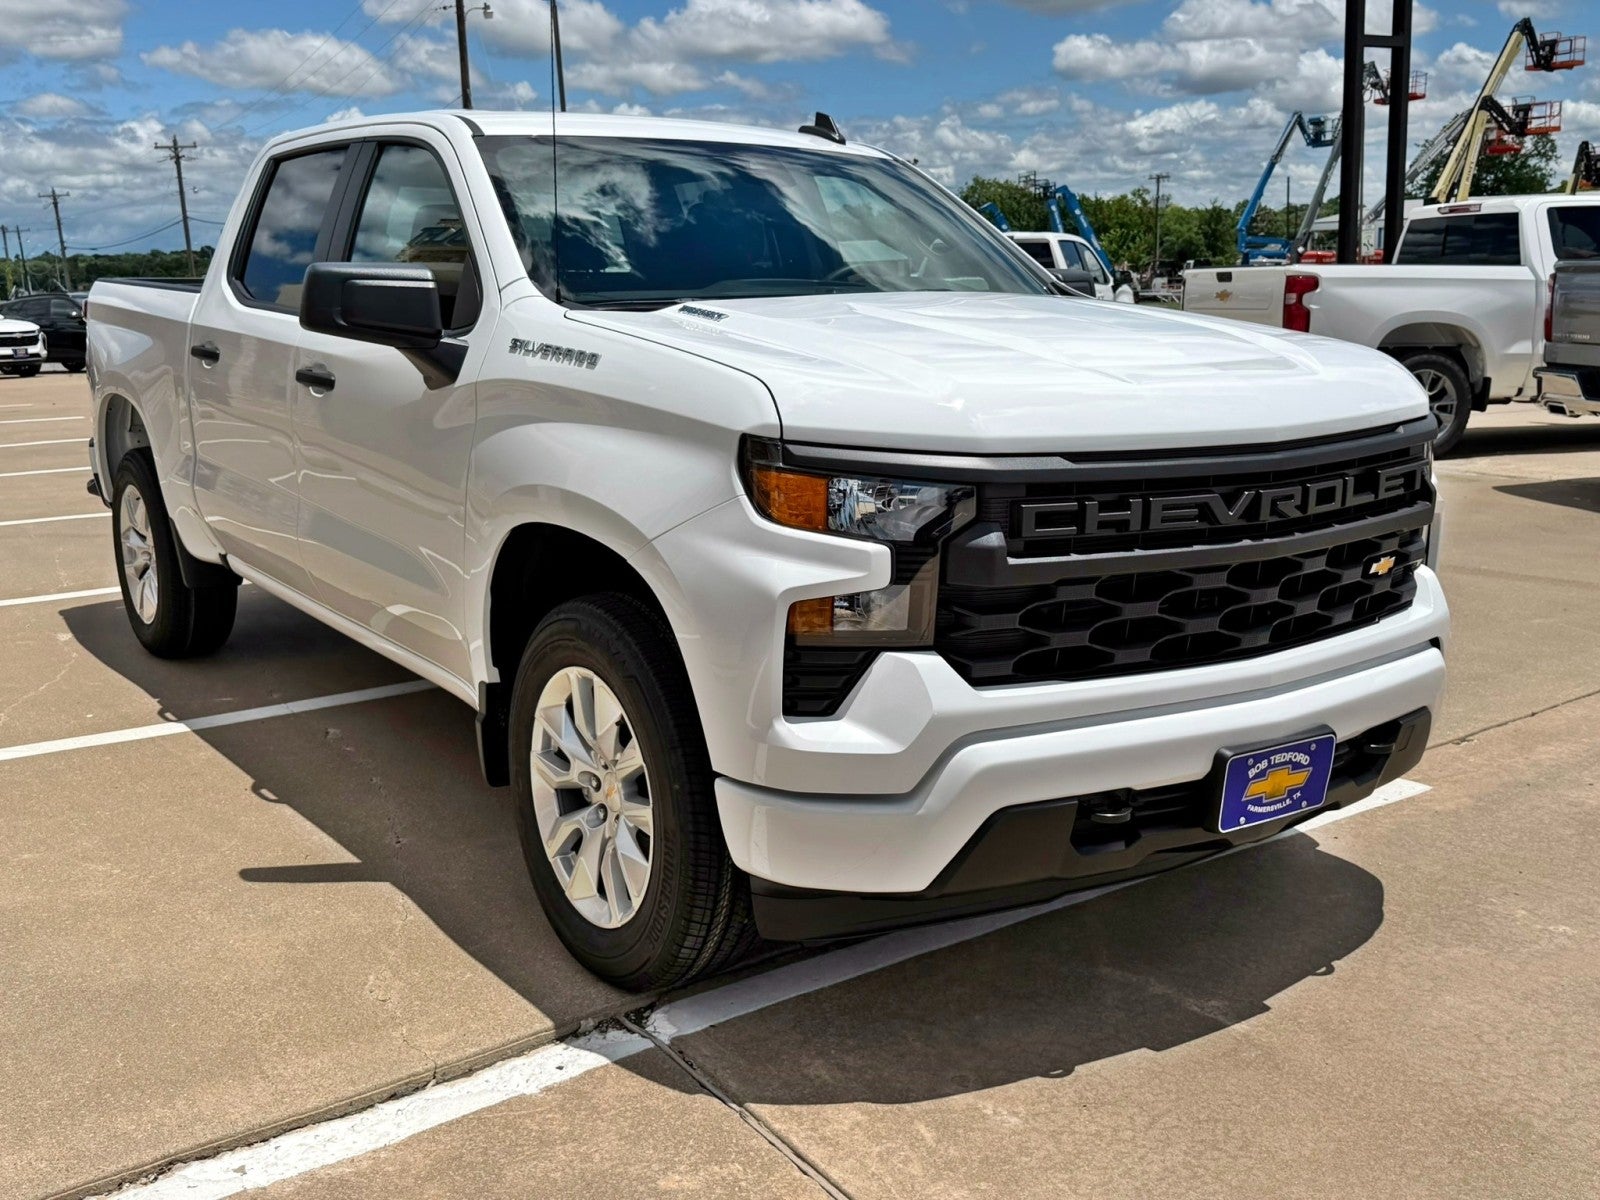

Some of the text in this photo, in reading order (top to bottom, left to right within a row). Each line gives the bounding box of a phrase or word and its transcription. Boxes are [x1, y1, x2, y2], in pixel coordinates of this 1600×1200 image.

[1020, 463, 1426, 537] CHEVROLET
[1248, 752, 1310, 778] BOB TEDFORD
[1293, 790, 1301, 801] TX
